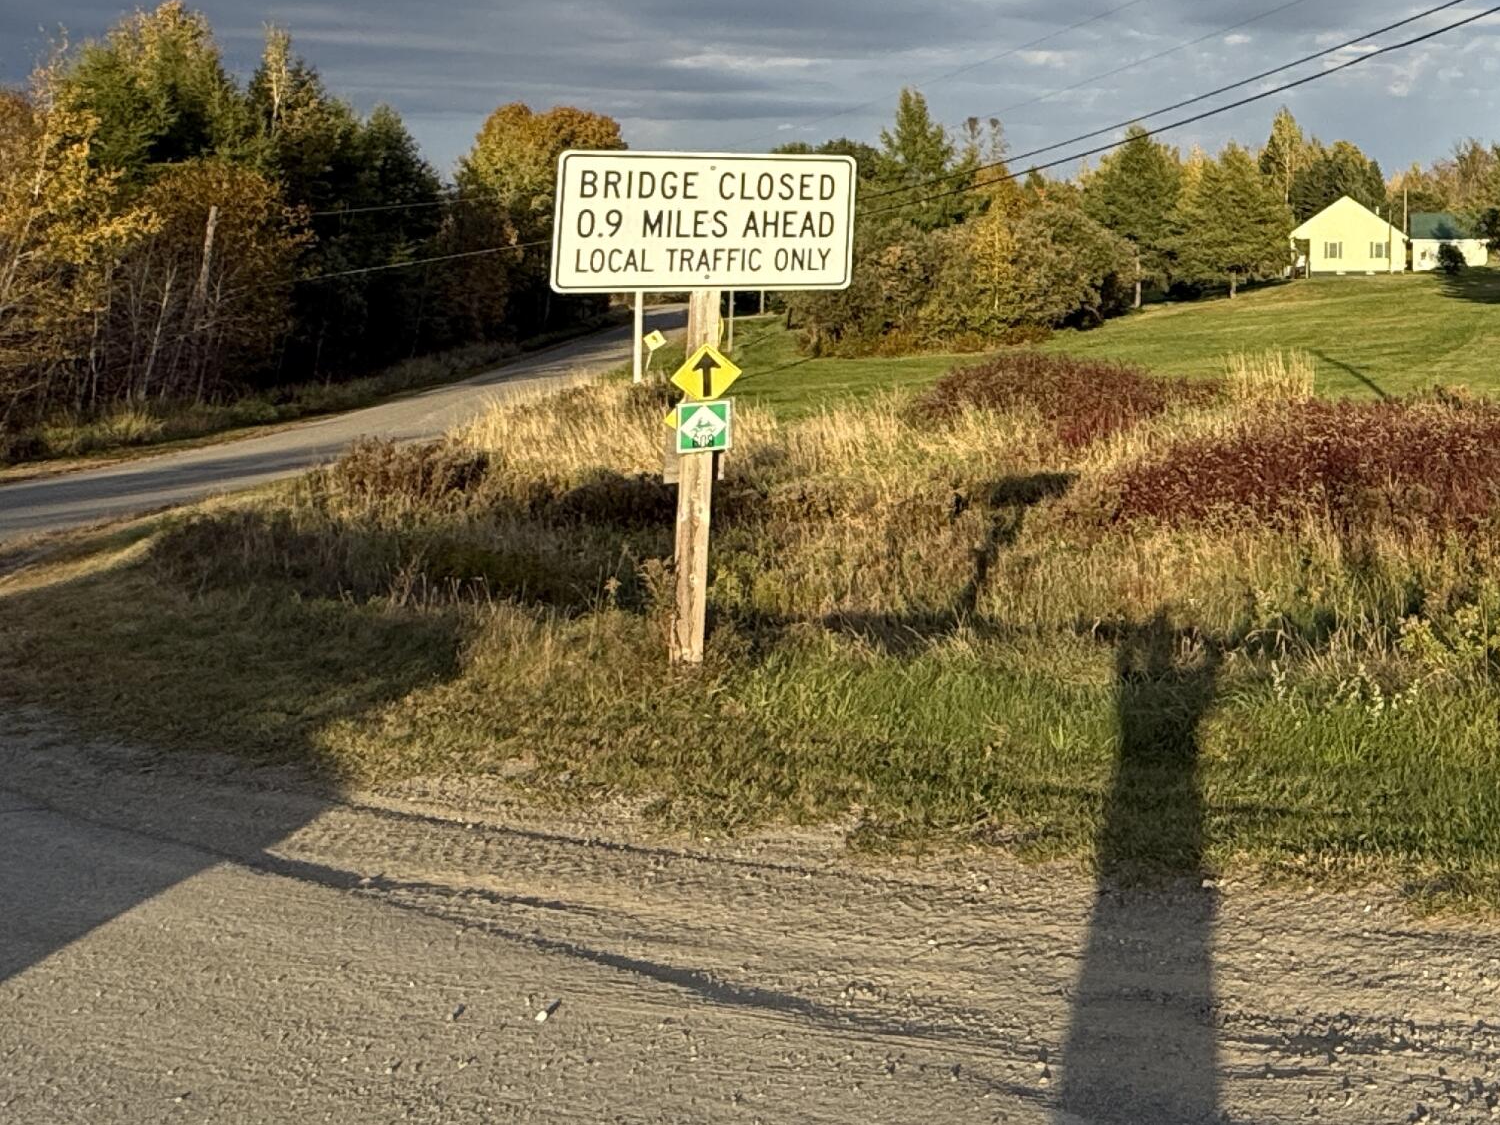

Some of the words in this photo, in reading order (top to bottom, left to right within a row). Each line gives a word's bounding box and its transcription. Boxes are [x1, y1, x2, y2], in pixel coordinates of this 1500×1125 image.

[579, 170, 699, 200] BRIDGE
[719, 172, 835, 201] CLOSED
[577, 208, 623, 238] 0.9
[642, 210, 728, 238] MILES
[742, 210, 835, 238] AHEAD
[575, 248, 654, 273] LOCAL
[666, 248, 762, 272] TRAFFIC
[774, 248, 831, 271] ONLY
